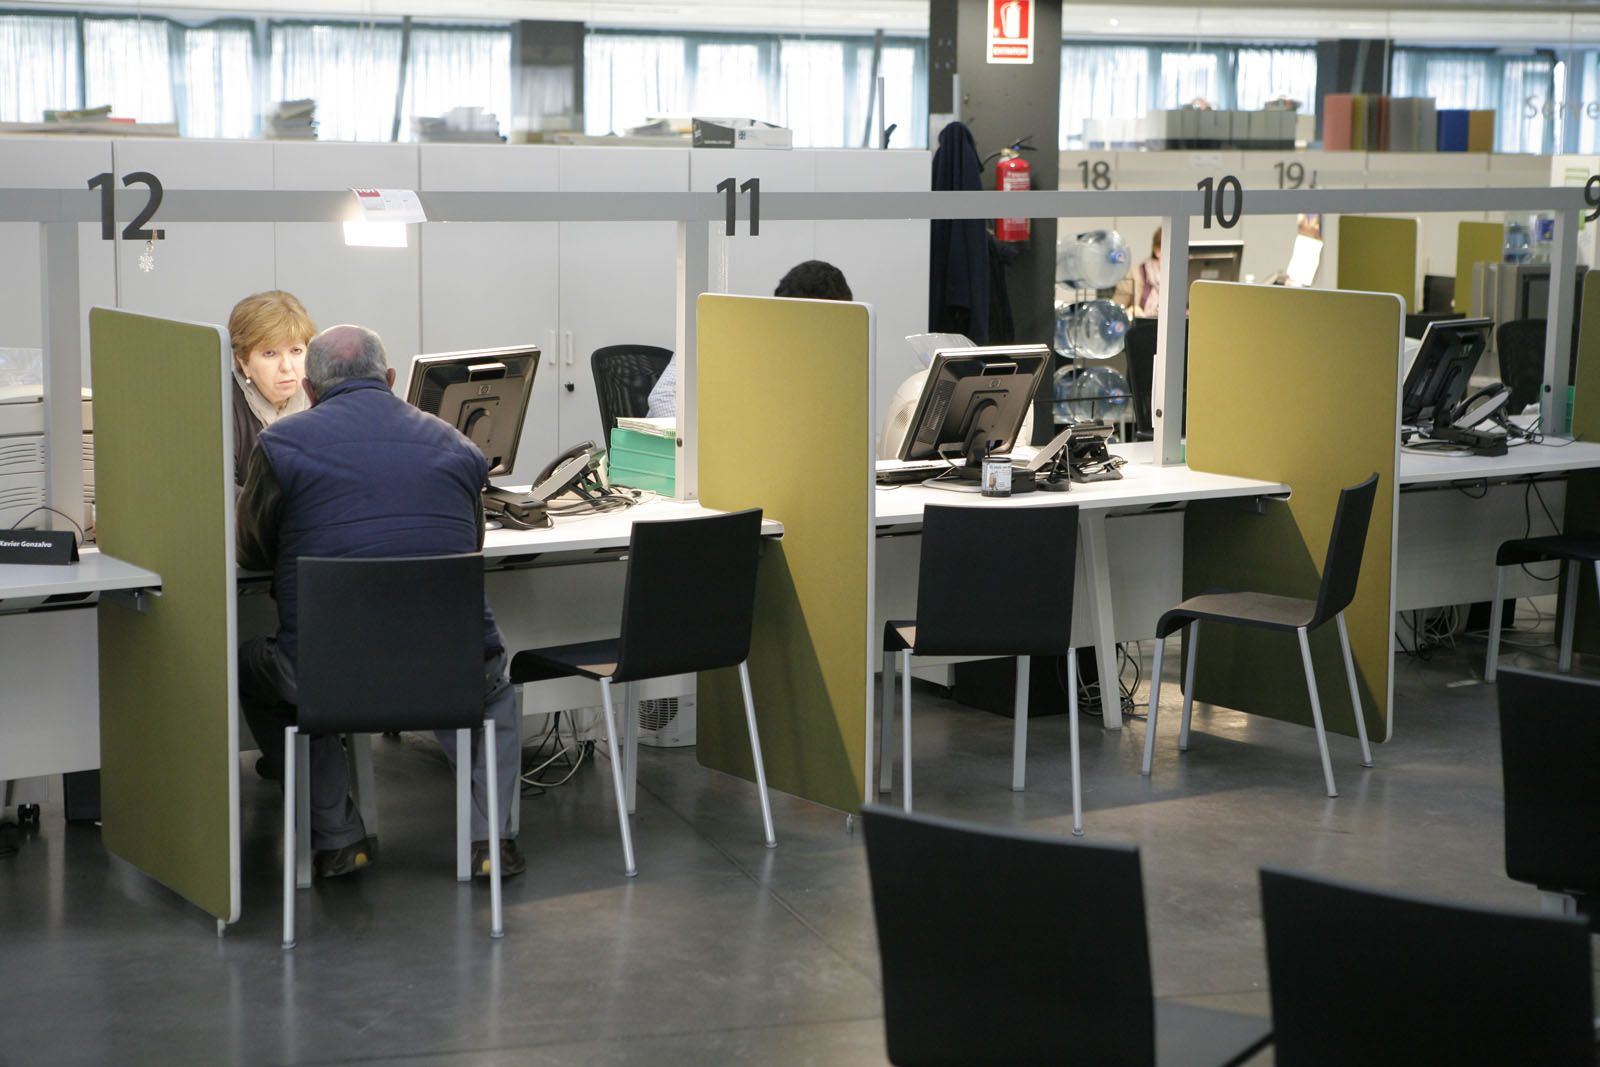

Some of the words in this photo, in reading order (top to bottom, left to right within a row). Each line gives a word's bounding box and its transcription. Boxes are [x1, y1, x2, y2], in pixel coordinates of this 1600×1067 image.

[1078, 160, 1111, 190] 18
[1274, 162, 1304, 189] 19
[1584, 174, 1600, 223] 9
[88, 171, 165, 240] 12
[716, 178, 760, 236] 11
[1197, 175, 1243, 229] 10
[21, 540, 52, 548] Gonzalvo
